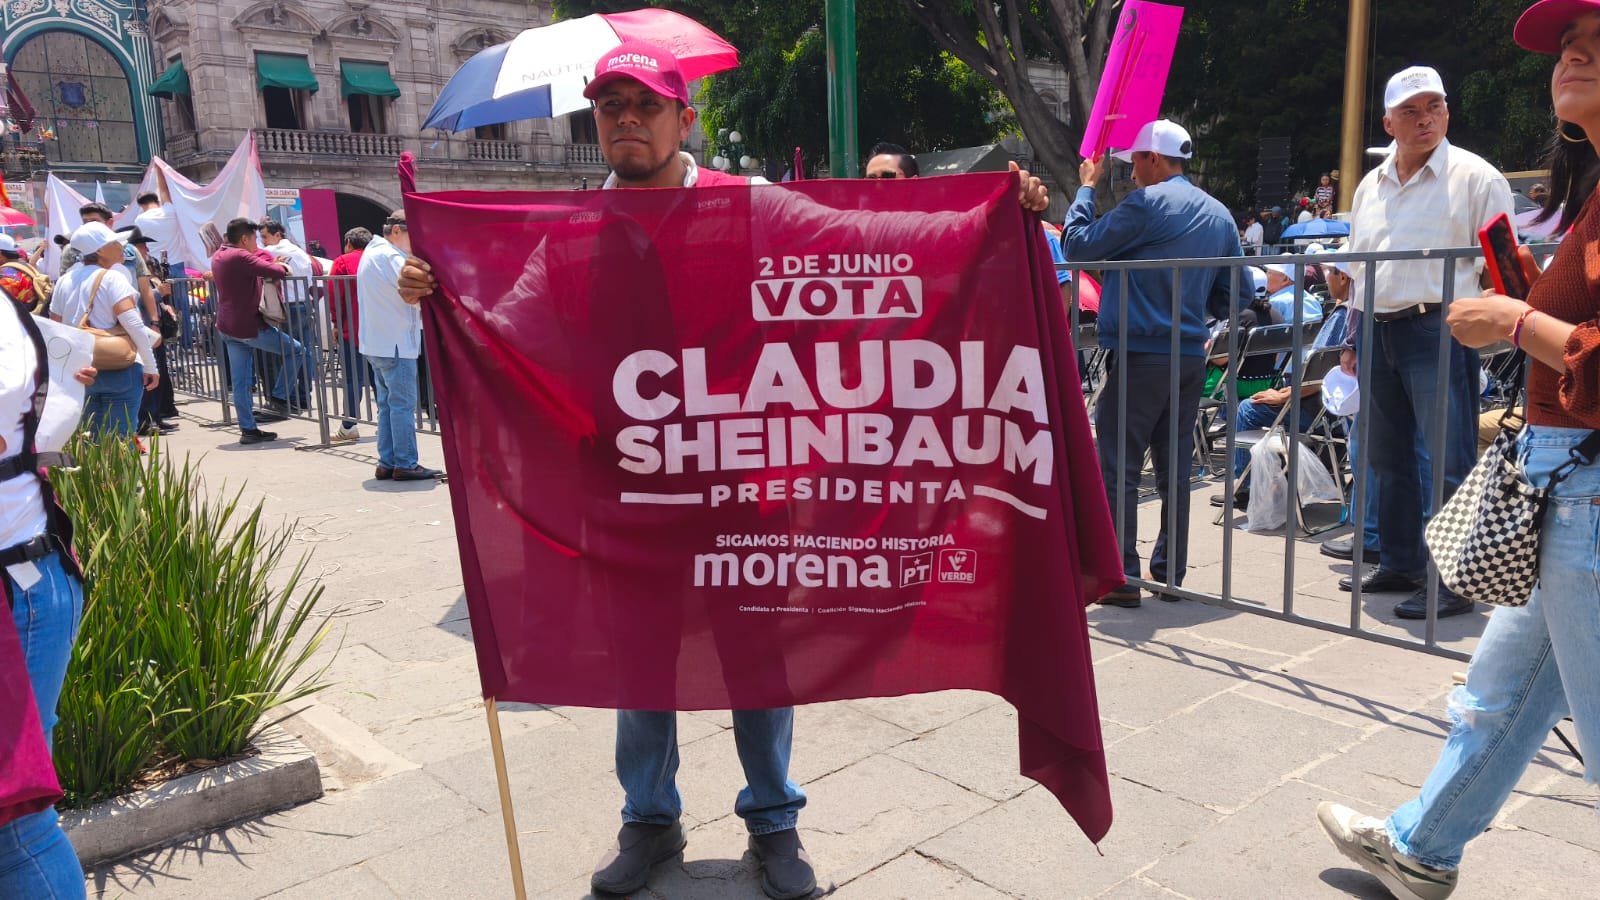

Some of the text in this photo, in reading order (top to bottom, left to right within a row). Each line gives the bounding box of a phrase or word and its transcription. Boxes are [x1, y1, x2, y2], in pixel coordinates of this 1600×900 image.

[522, 61, 595, 82] NAUTIC
[607, 53, 658, 68] morena
[759, 252, 914, 275] 2 DE JUNIO
[756, 280, 918, 316] VOTA
[612, 339, 1050, 424] CLAUDIA
[615, 413, 1054, 486] SHEINBAUM
[711, 478, 966, 507] PRESIDENTA
[716, 533, 955, 551] SIGAMOS HACIENDO HISTORIA
[694, 552, 893, 588] morena
[903, 565, 930, 584] PT
[940, 572, 974, 581] VERDE
